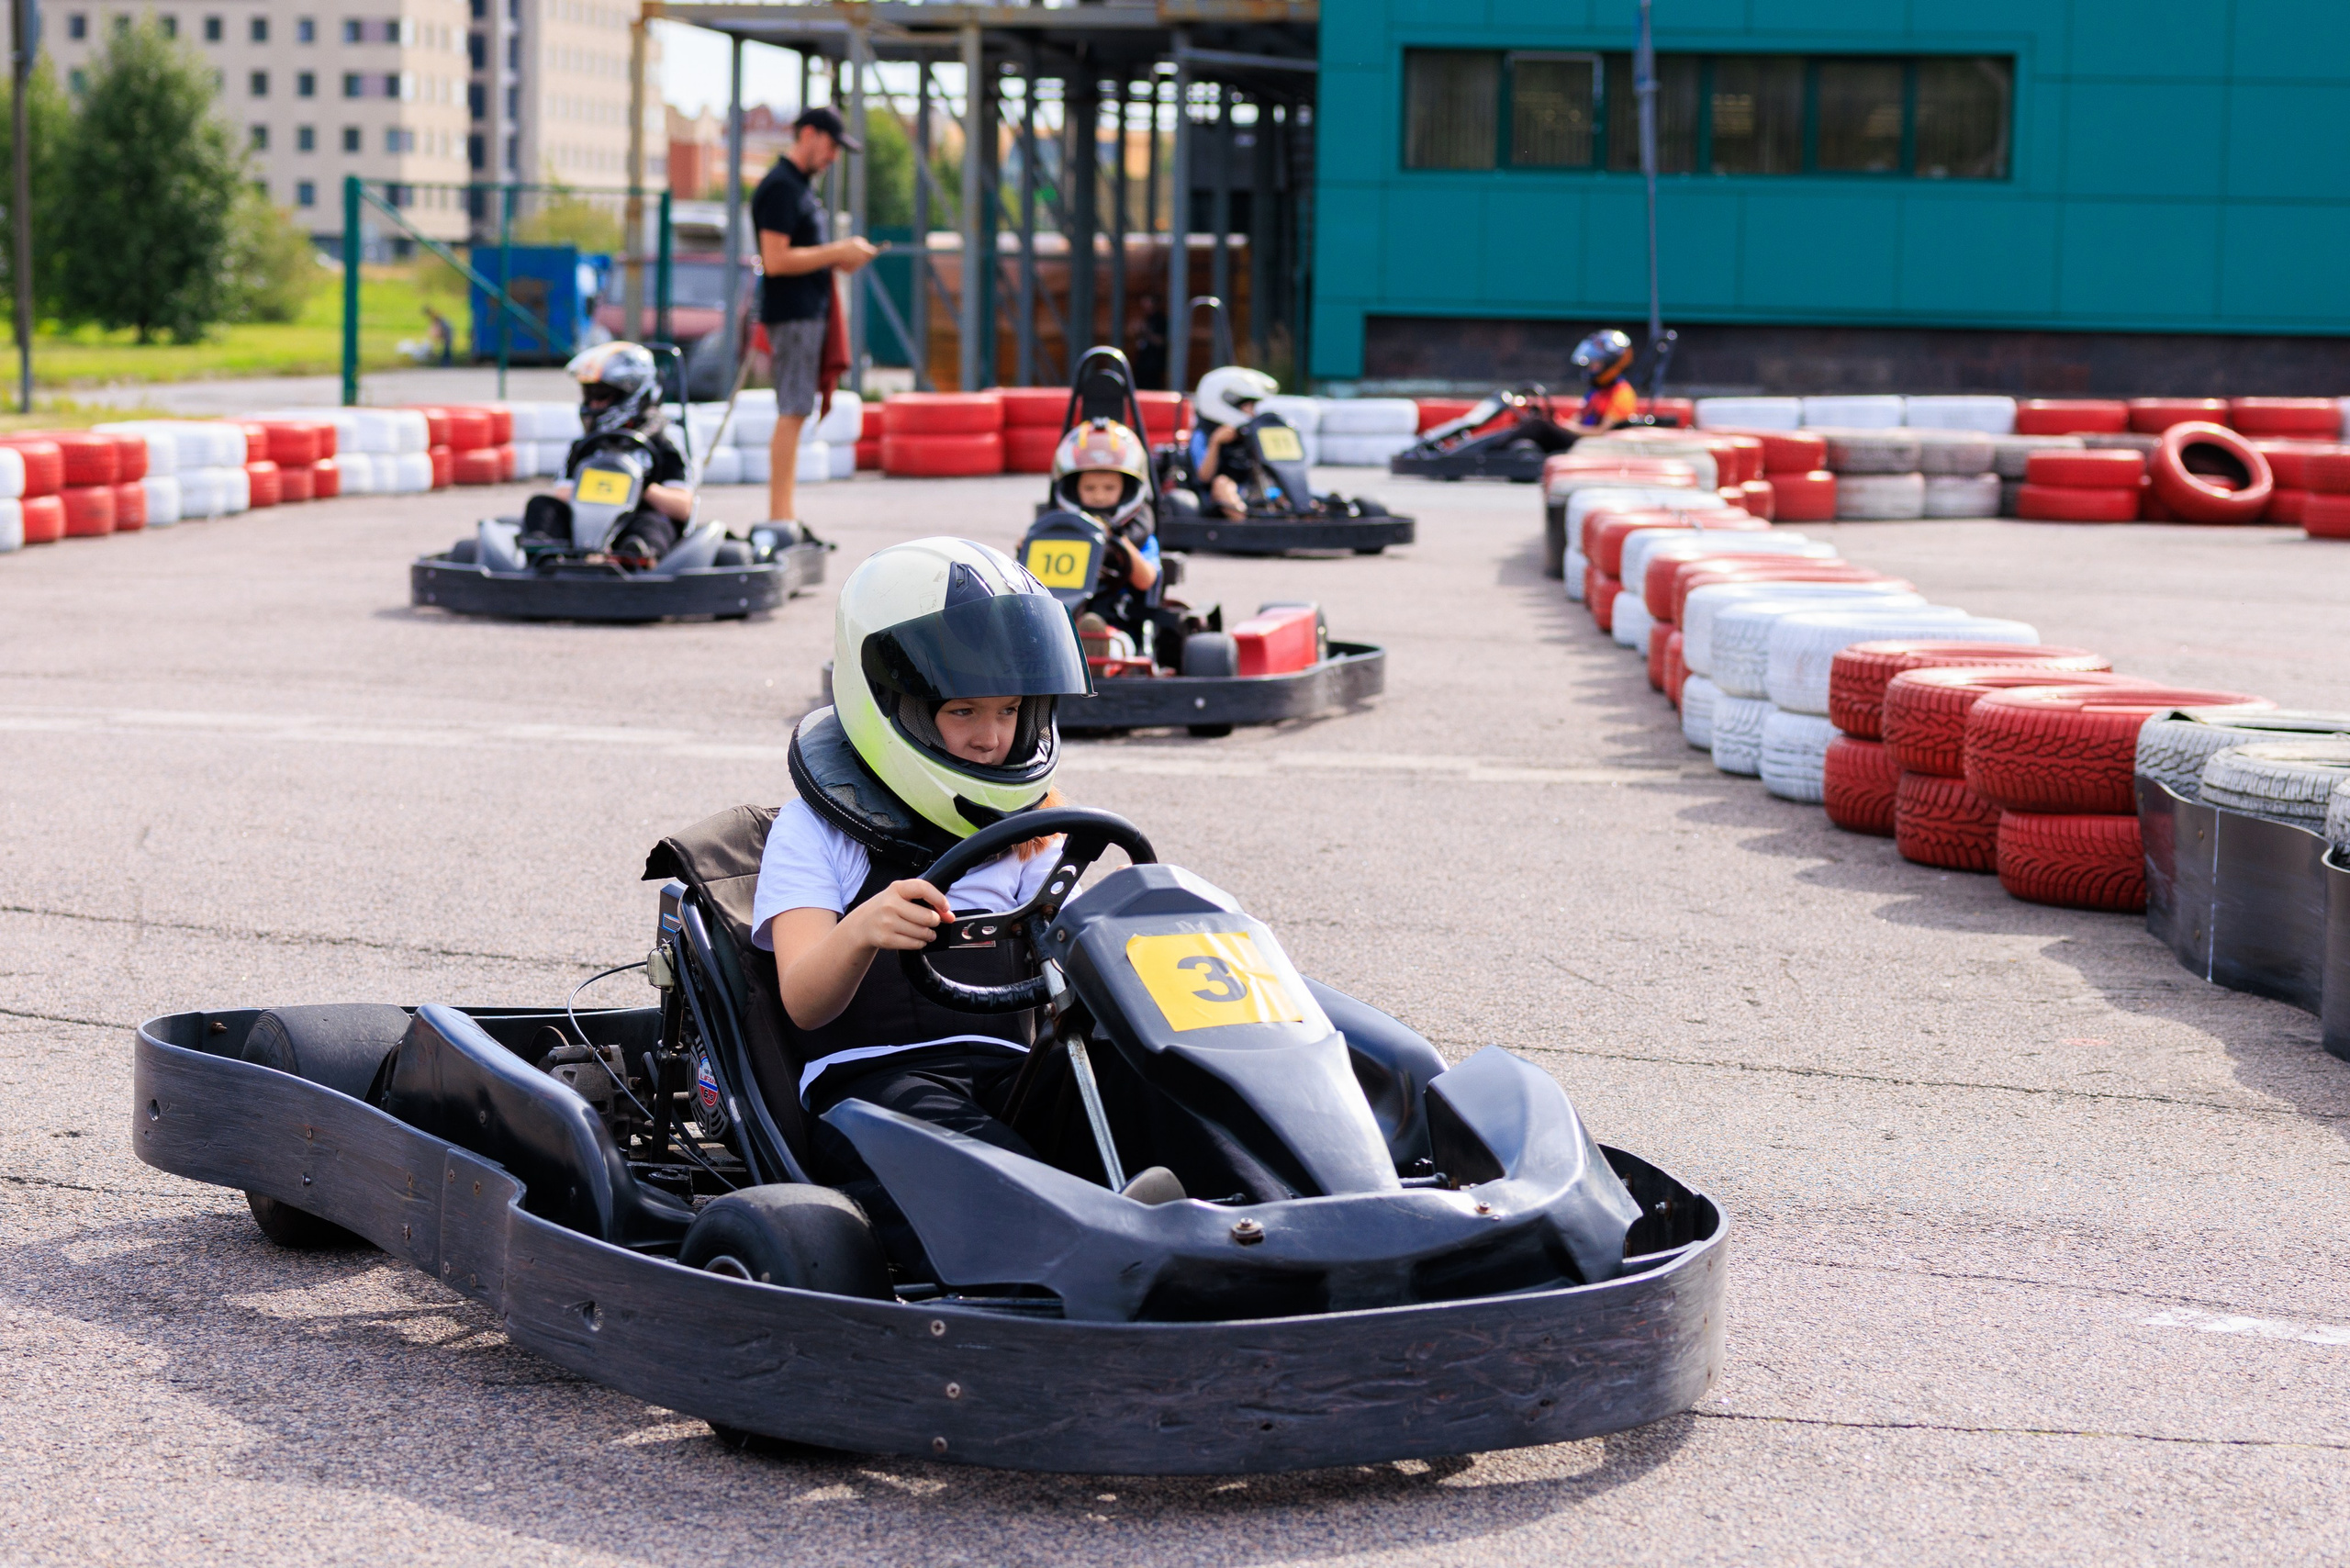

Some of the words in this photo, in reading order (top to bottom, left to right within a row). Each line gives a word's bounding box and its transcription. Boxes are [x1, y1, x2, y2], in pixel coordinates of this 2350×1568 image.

[1044, 553, 1075, 576] 10
[1177, 956, 1248, 1002] 3
[703, 1089, 714, 1102] 6.5
